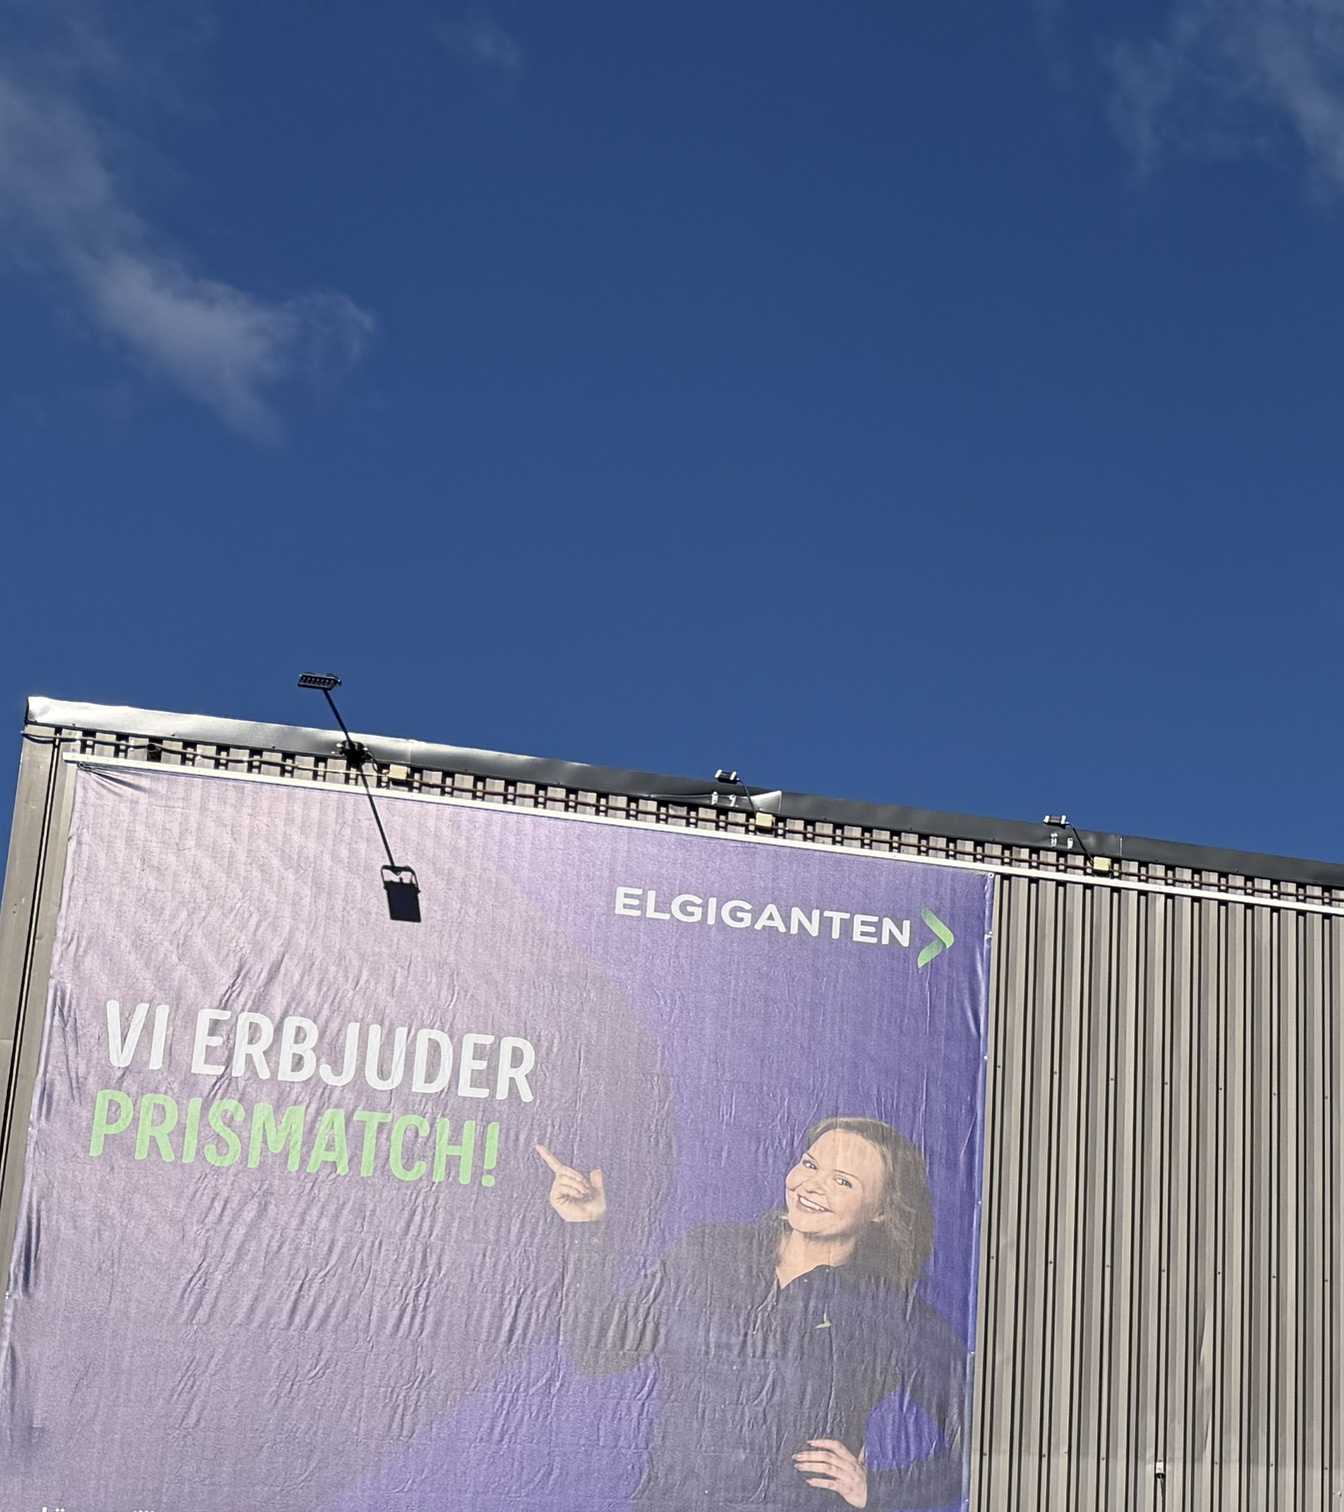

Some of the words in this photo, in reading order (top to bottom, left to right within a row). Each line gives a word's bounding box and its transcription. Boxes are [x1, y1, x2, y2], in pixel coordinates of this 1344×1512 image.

[613, 885, 911, 949] ELGIGANTEN
[104, 999, 168, 1071] VI
[189, 1006, 535, 1103] ERBJUDER
[88, 1089, 500, 1187] PRISMATCH!
